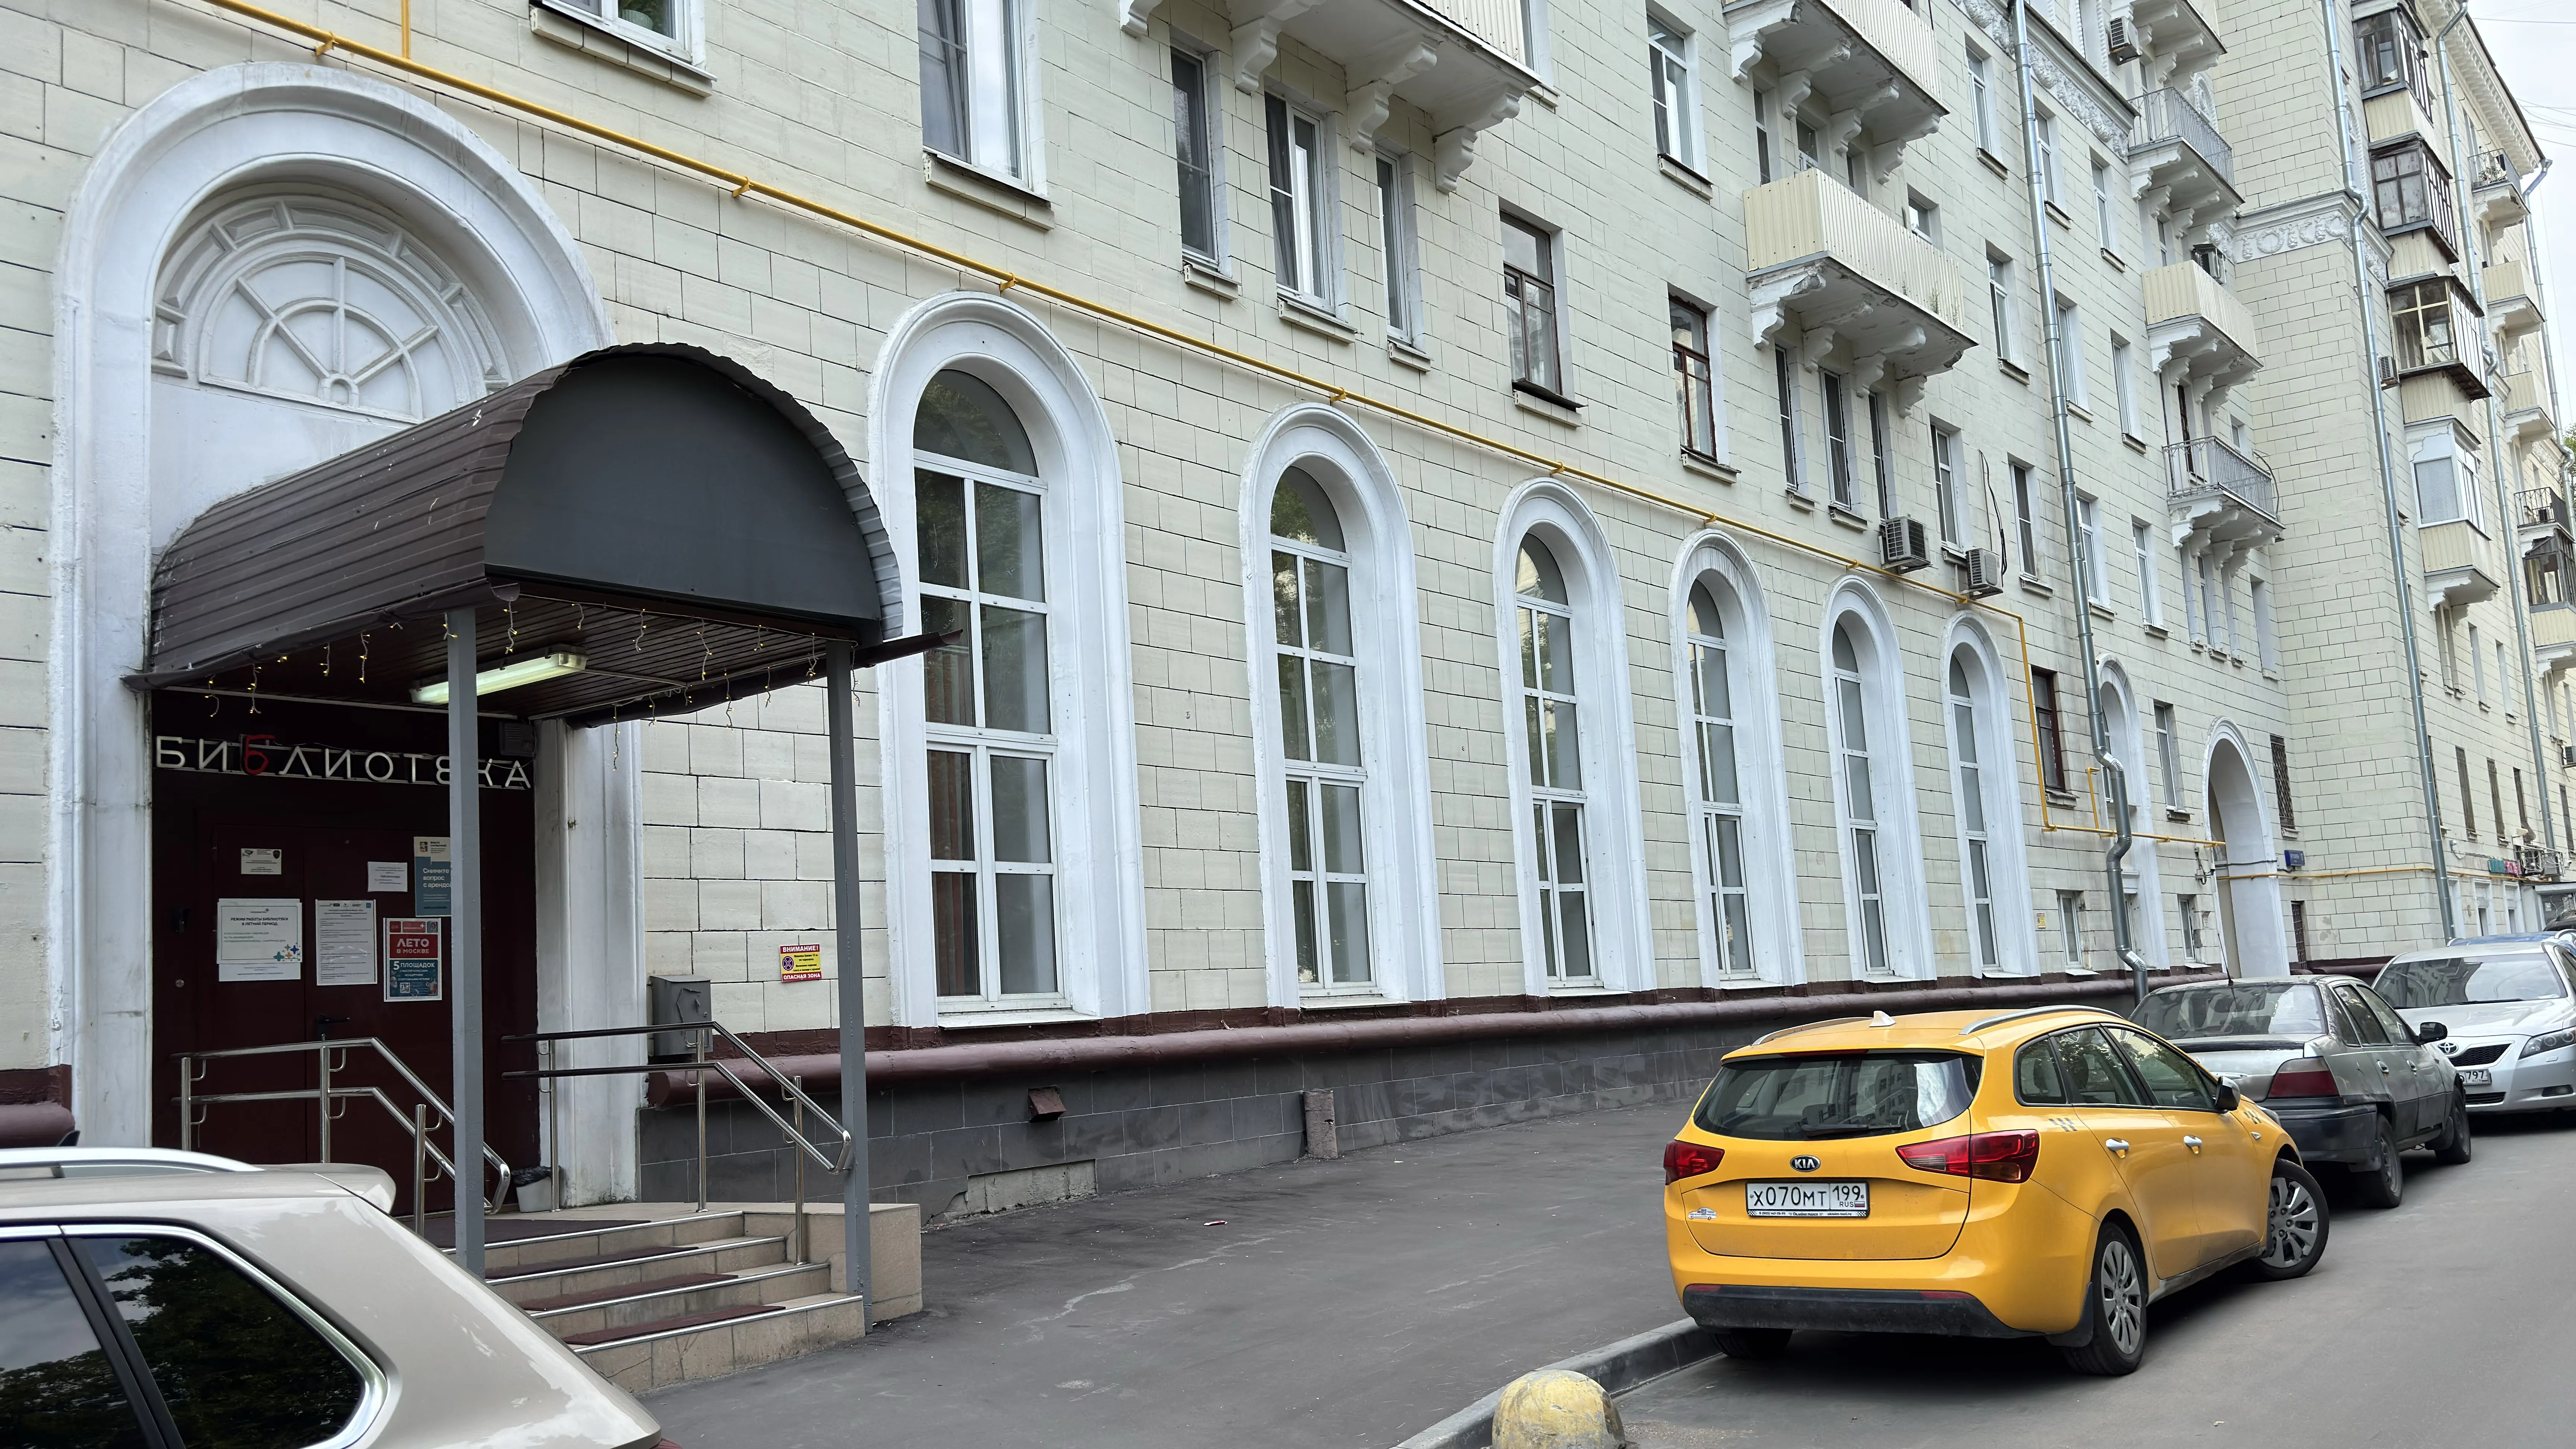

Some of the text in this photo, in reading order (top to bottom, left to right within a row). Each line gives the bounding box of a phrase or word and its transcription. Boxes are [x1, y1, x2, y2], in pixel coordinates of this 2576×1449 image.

[397, 938, 429, 947] ЛЕТО
[393, 961, 400, 970] 5
[2466, 1070, 2484, 1080] 797
[1794, 1159, 1815, 1168] KIA
[1753, 1186, 1860, 1206] Х070МТ 199
